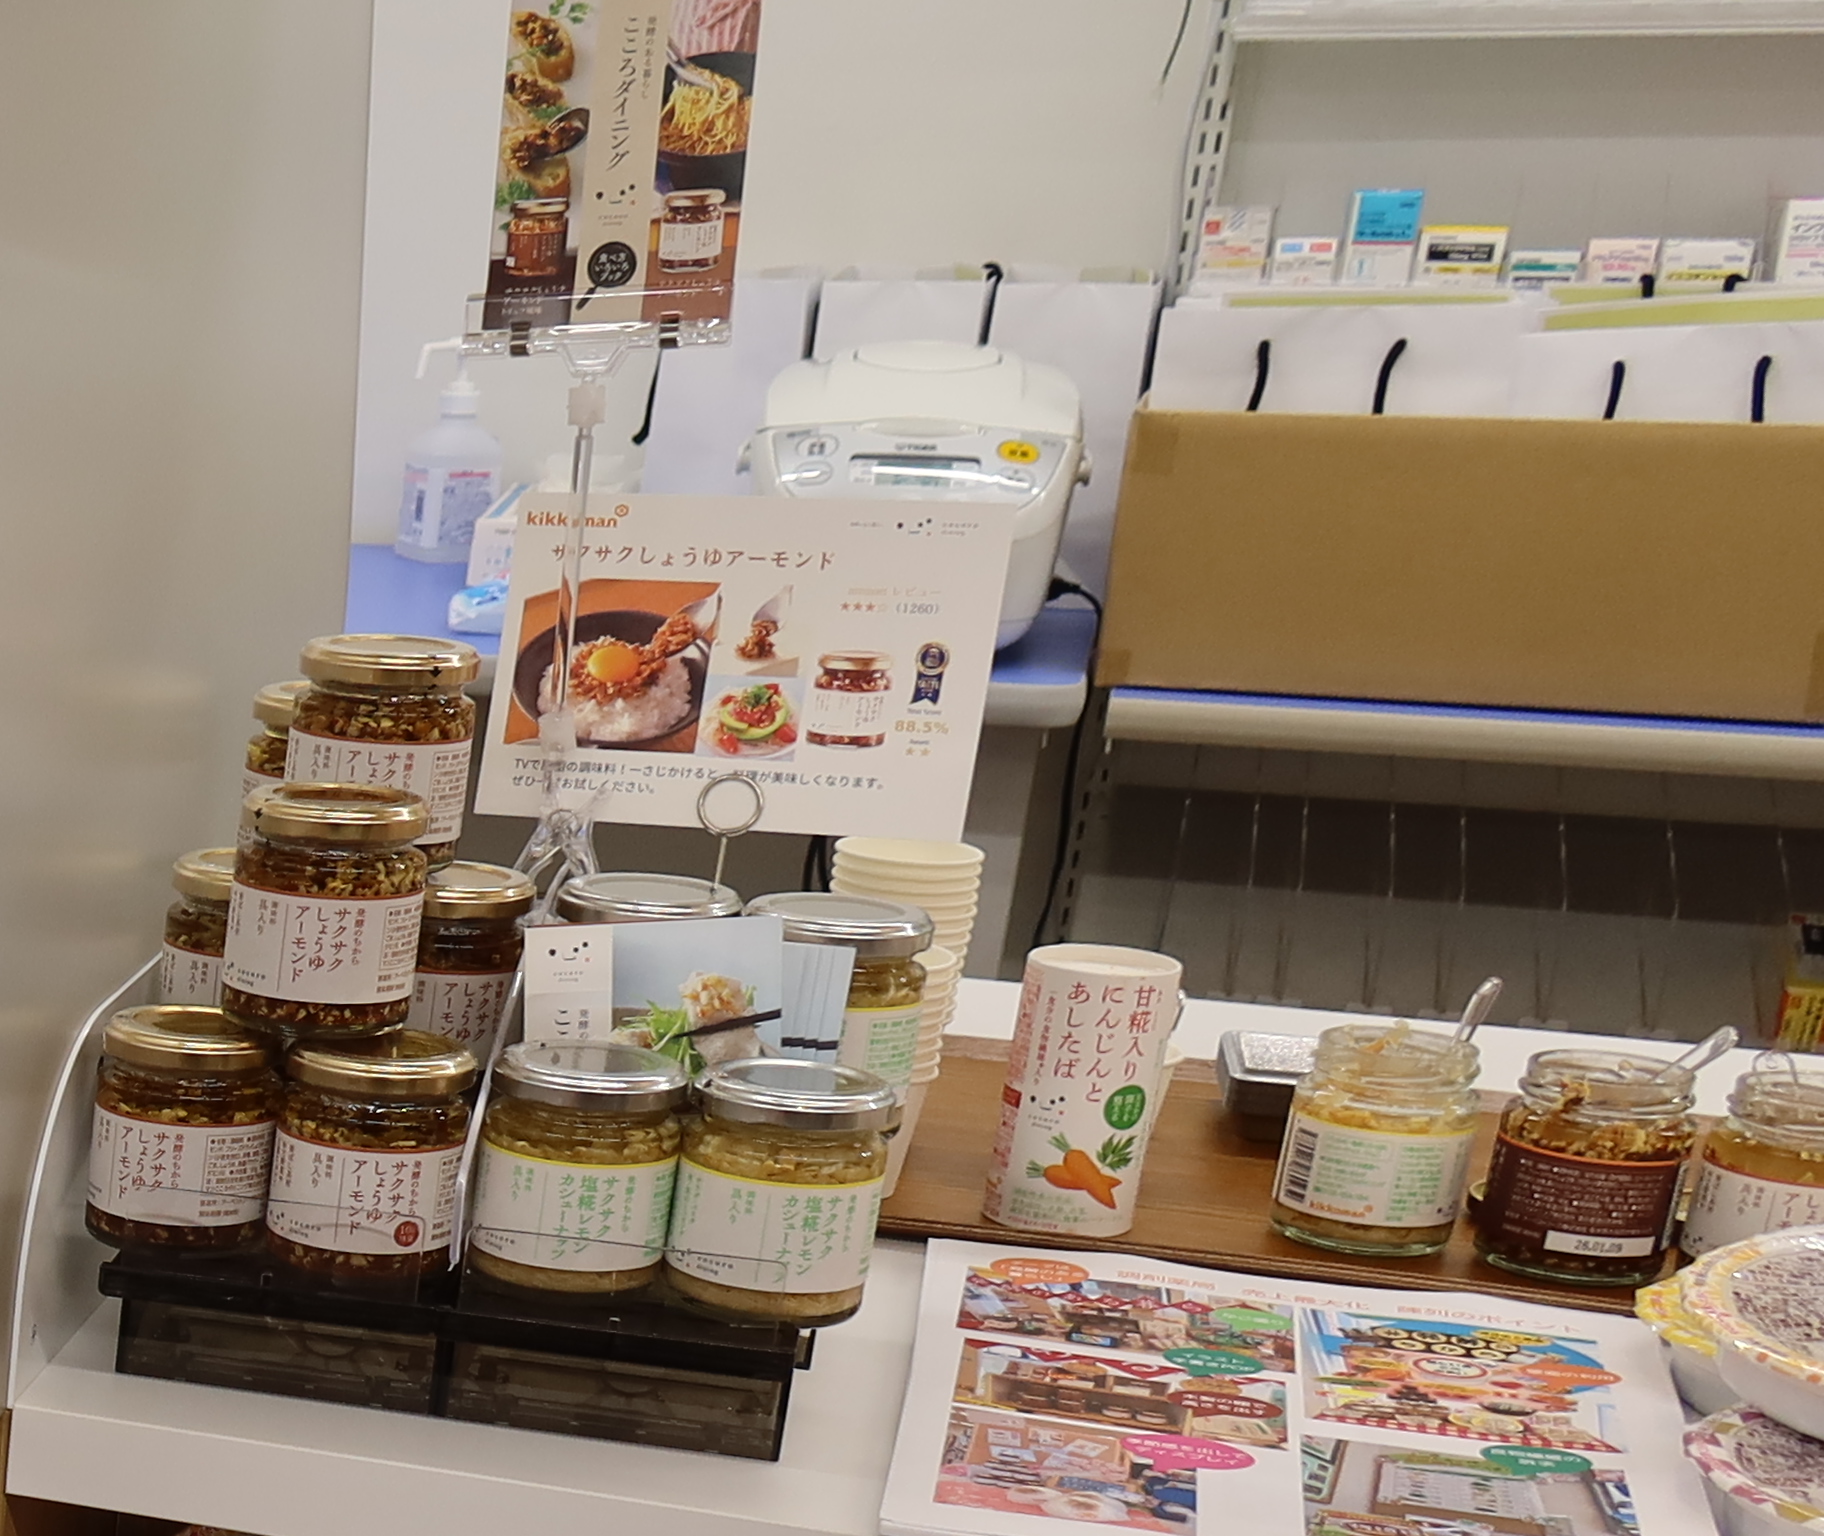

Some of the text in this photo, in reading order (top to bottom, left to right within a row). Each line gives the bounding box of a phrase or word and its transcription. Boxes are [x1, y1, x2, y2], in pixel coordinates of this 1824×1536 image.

[606, 17, 640, 171] こころダイニング
[288, 904, 310, 982] アーモンド
[308, 906, 328, 971] しょうゆ
[328, 907, 350, 973] サクサク
[351, 907, 367, 965] 発酵のちから
[1054, 981, 1090, 1078] あしたば
[1086, 986, 1124, 1102] にんじんと
[1123, 986, 1156, 1081] 甘糀入り
[118, 1125, 132, 1199] アーモンド
[132, 1128, 151, 1191] しょうゆ
[151, 1131, 168, 1191] サクサク
[367, 1160, 386, 1224] しょうゆ
[385, 1161, 408, 1226] サクサク
[347, 1159, 367, 1235] アーモンド
[574, 1175, 598, 1253] 塩糀レモン
[595, 1176, 620, 1238] サクサク
[819, 1195, 843, 1259] サクサク
[796, 1195, 825, 1276] 塩糀レモン
